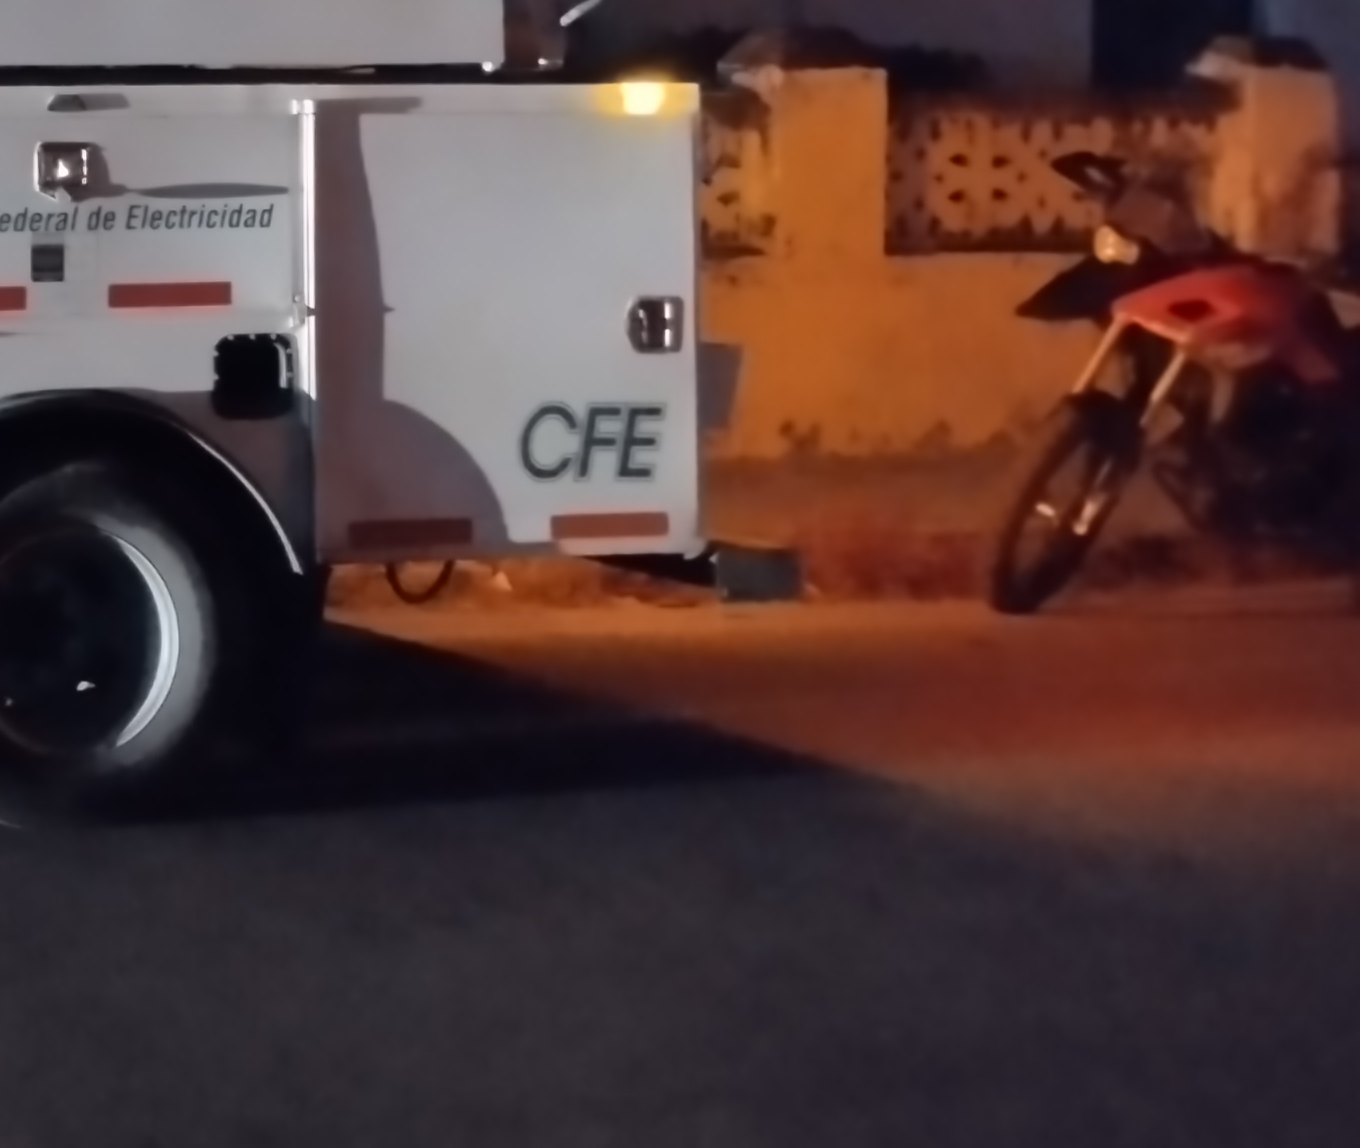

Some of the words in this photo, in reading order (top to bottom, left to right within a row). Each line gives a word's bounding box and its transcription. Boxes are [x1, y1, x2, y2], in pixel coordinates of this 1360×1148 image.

[86, 205, 117, 232] de
[125, 203, 275, 230] Electricidad
[519, 403, 665, 481] CFE
